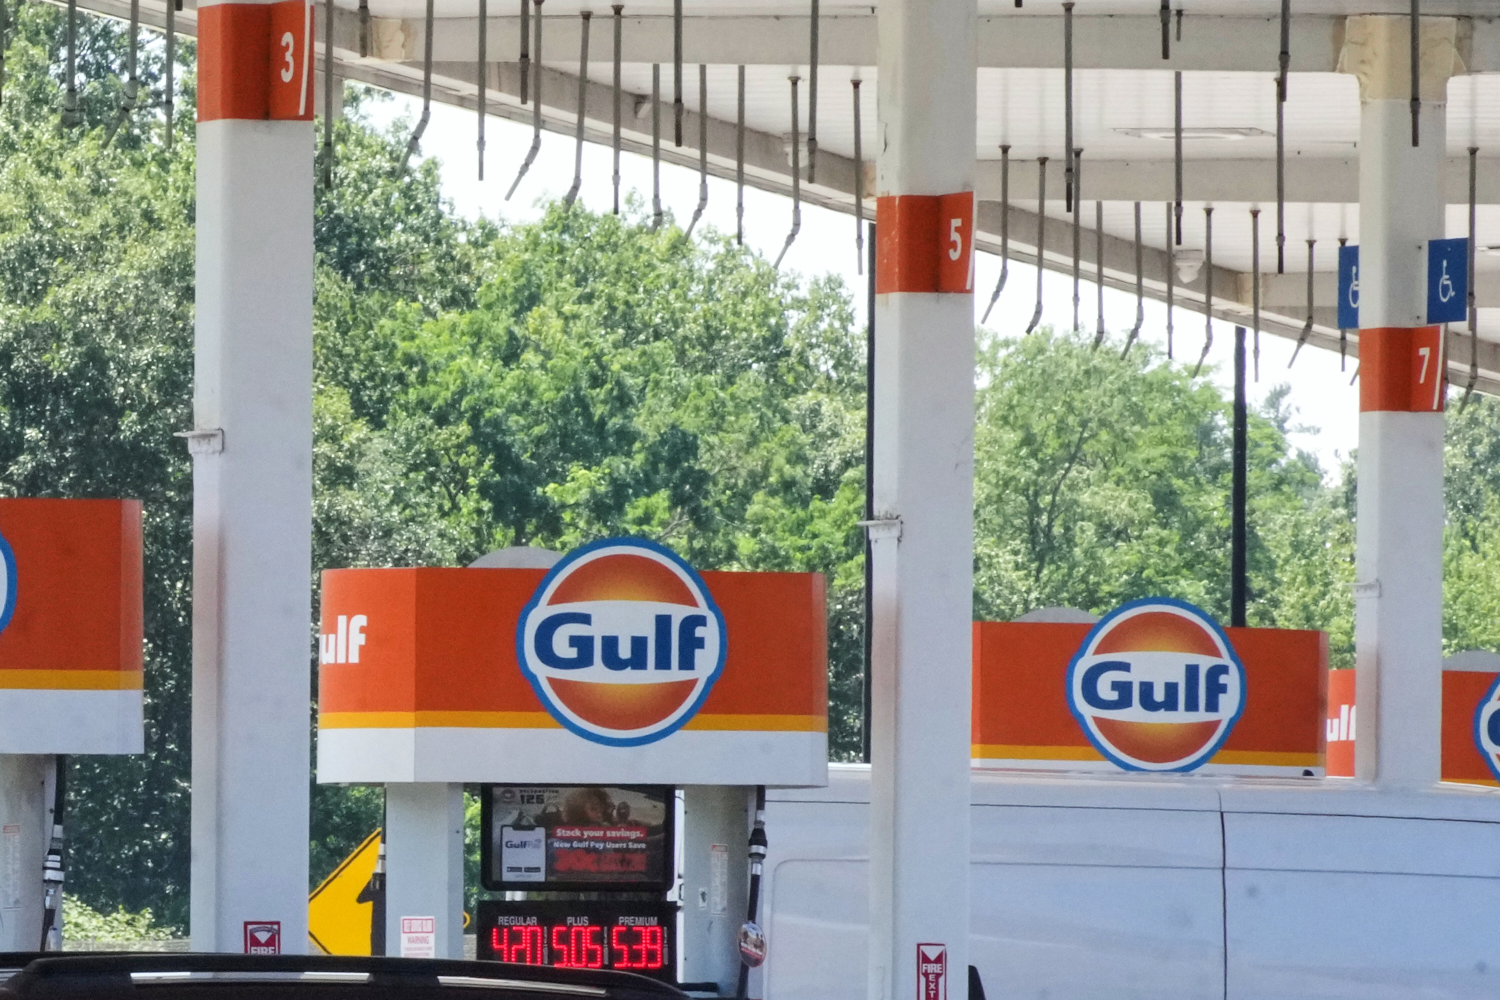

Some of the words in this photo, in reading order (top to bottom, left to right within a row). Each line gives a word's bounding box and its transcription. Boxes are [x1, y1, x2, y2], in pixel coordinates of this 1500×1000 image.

[319, 614, 367, 664] ulf
[534, 611, 708, 671] Gulf
[1080, 660, 1229, 713] Gulf
[498, 916, 537, 926] REGULAR
[566, 916, 589, 926] PLUS
[618, 916, 658, 926] PREMIUM
[922, 963, 943, 974] FIRE
